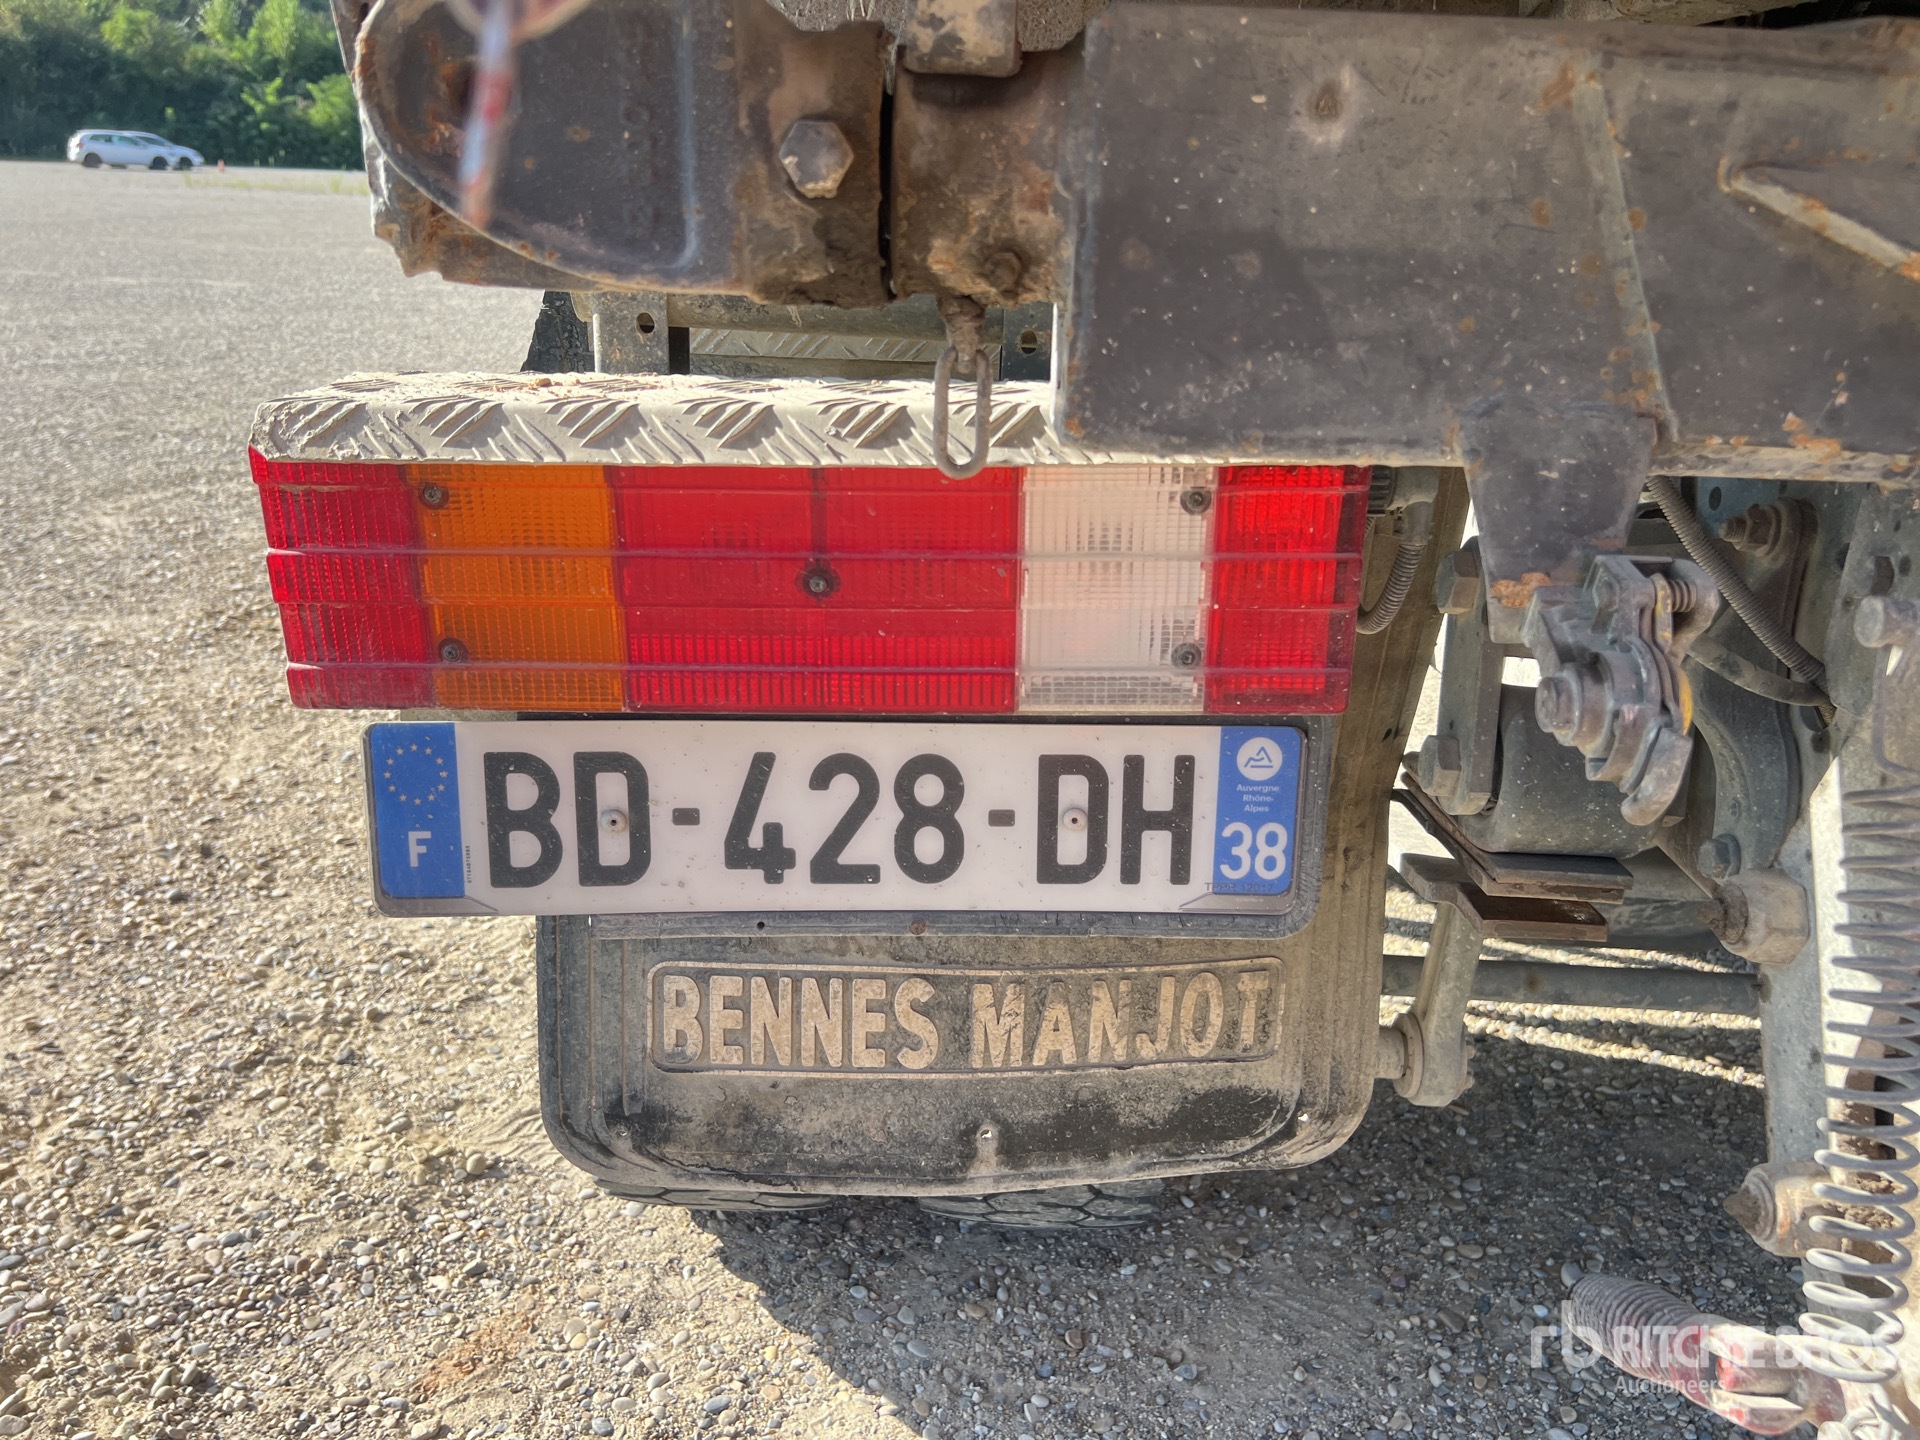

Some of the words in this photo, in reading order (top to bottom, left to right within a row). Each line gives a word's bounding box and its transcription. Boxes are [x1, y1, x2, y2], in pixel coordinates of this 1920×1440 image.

[1236, 784, 1280, 793] Auvergne
[1242, 794, 1275, 802] Rhône-
[483, 751, 1196, 888] BD-428-DH
[1243, 804, 1270, 813] Alpes
[407, 831, 432, 868] F
[1219, 821, 1288, 881] 38
[661, 974, 940, 1070] BENNES
[970, 969, 1271, 1069] MANJOT
